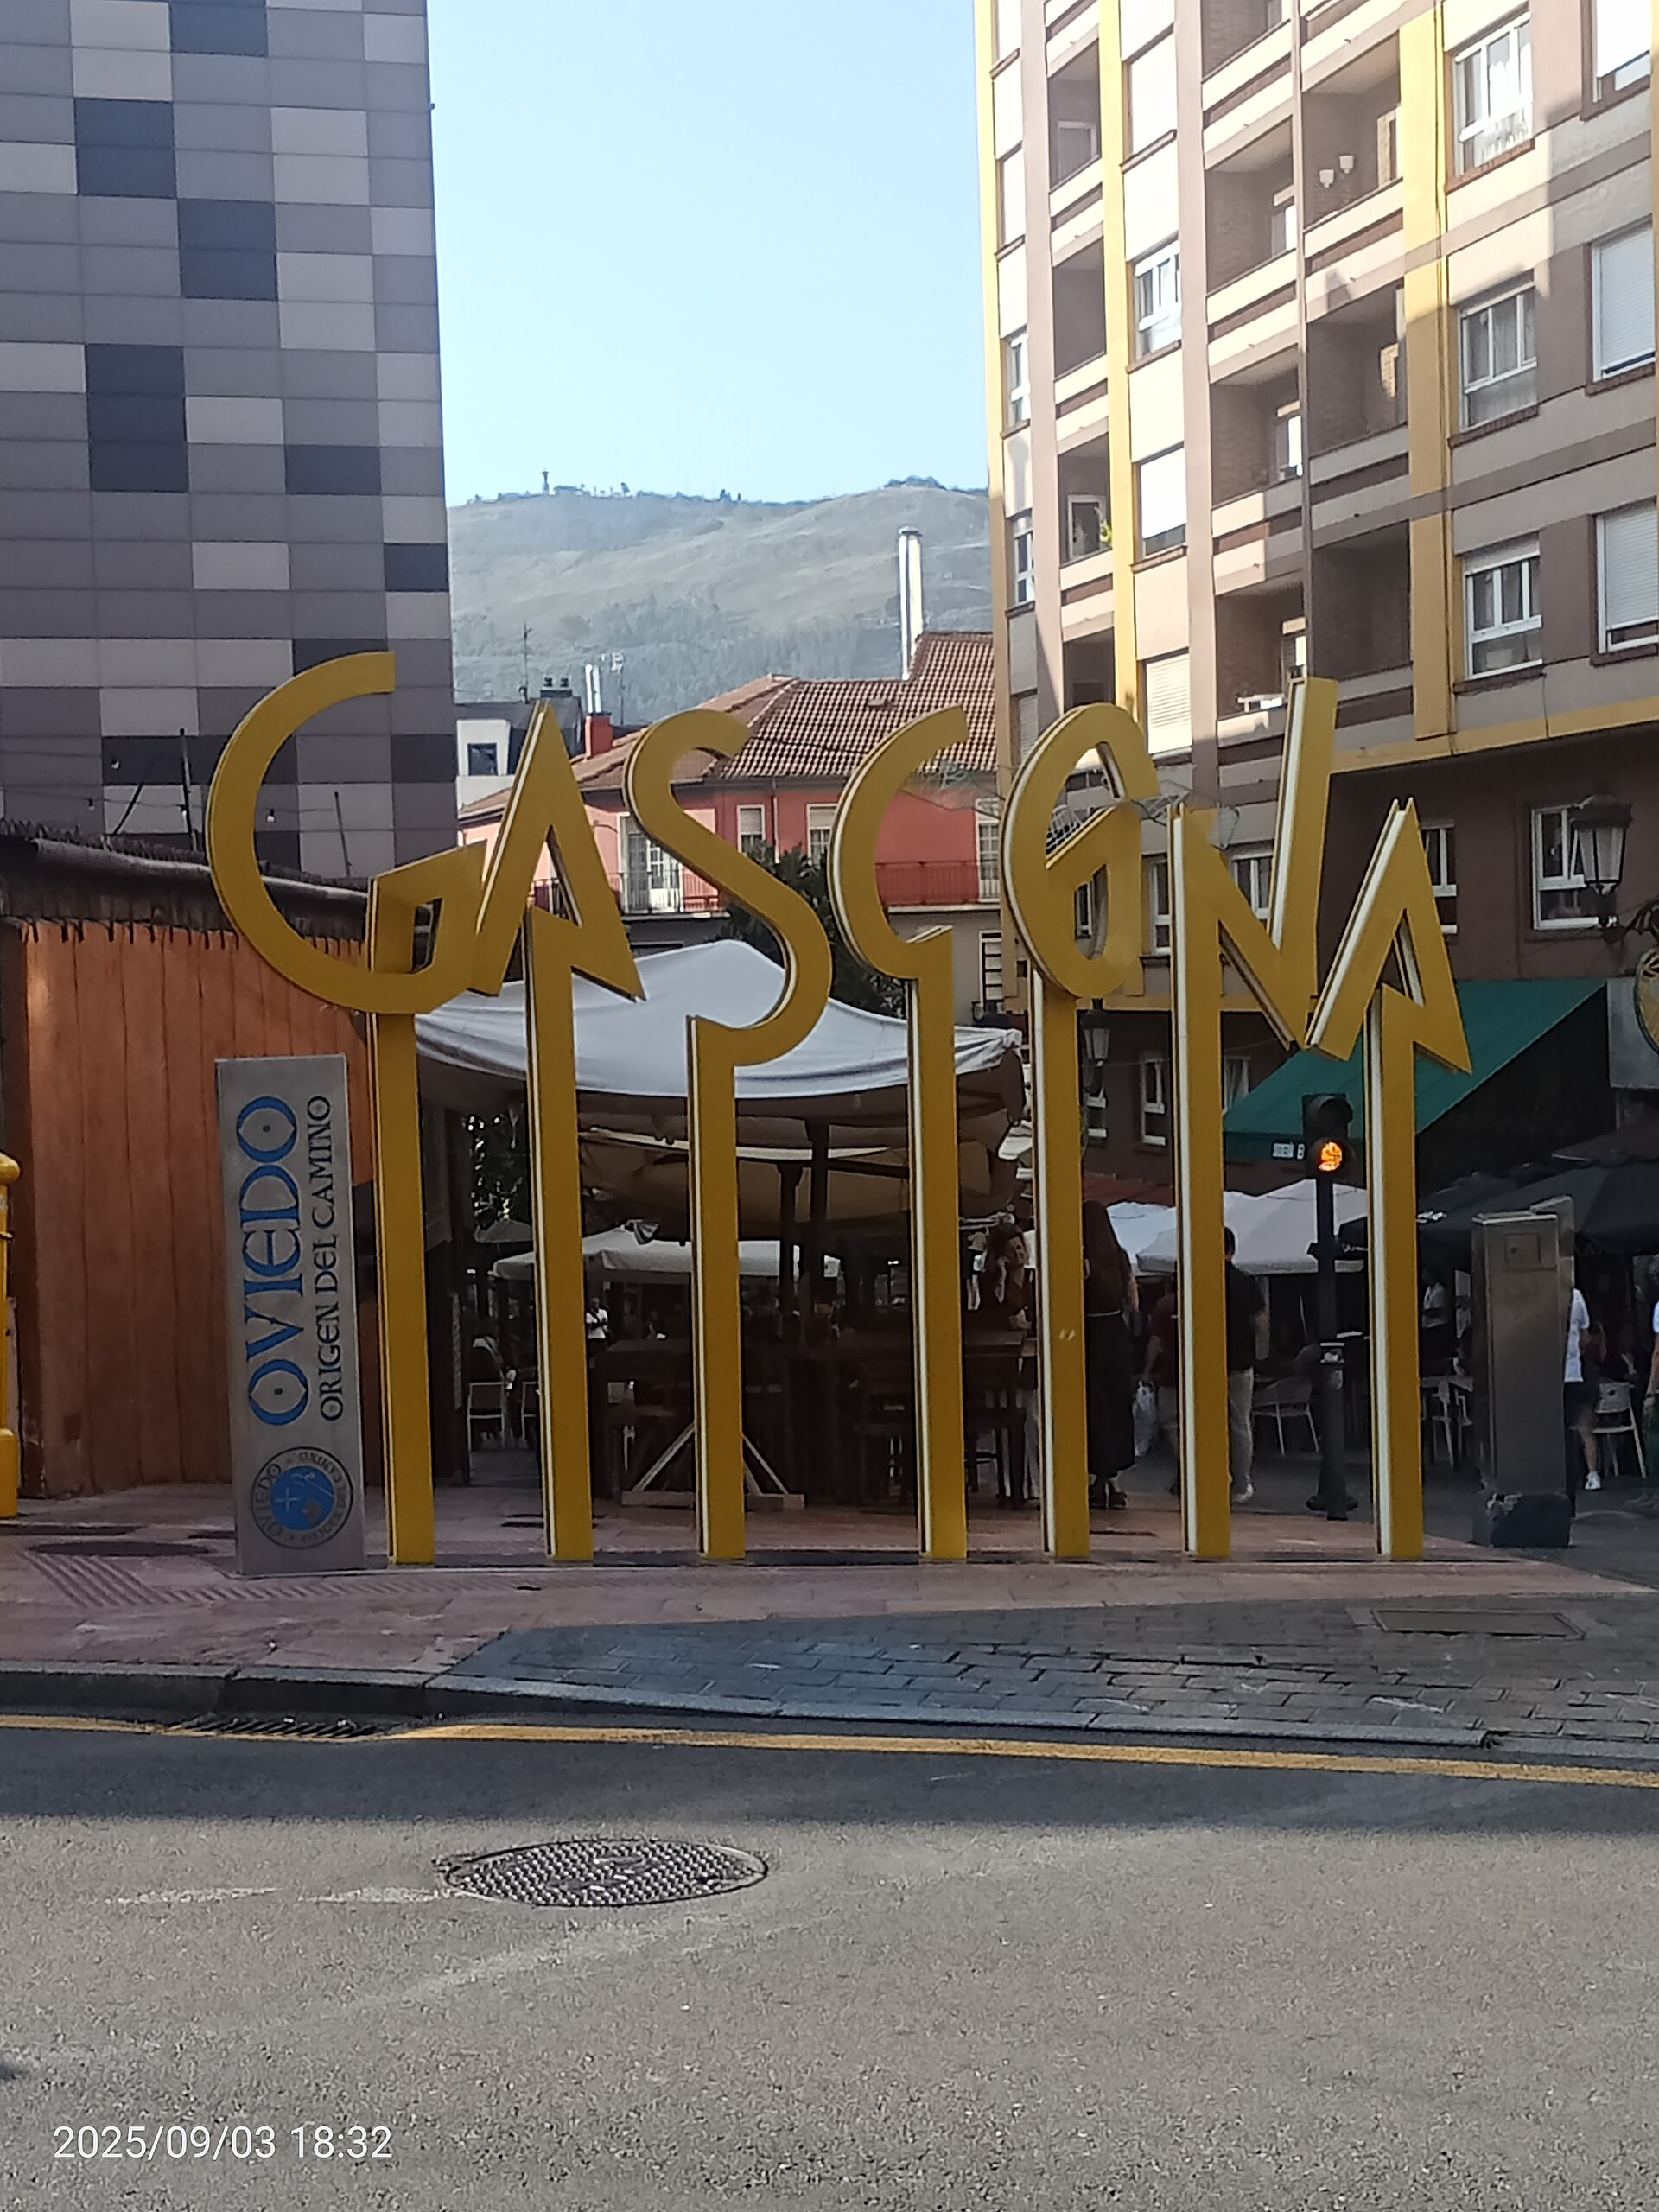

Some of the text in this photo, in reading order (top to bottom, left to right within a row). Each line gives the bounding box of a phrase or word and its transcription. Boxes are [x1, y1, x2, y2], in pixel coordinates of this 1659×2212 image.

[236, 1096, 309, 1426] OVIEDO
[307, 1095, 344, 1422] ORIGEN DEL CAMINO
[254, 1463, 283, 1537] OVIEDO
